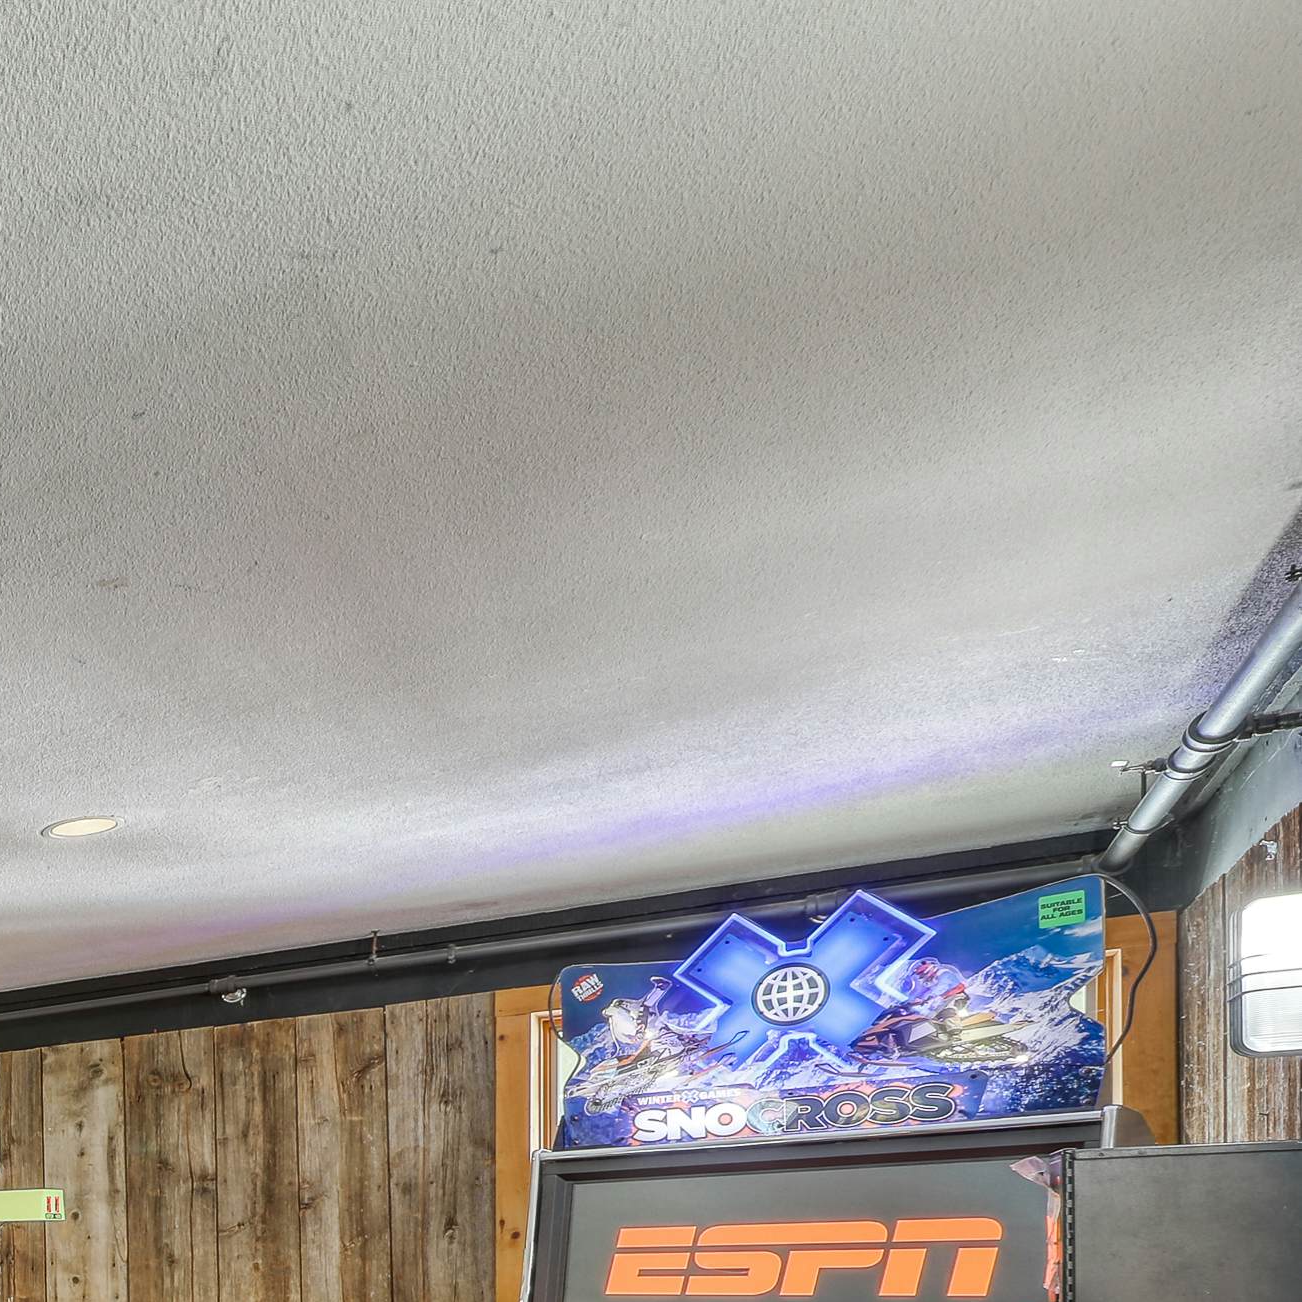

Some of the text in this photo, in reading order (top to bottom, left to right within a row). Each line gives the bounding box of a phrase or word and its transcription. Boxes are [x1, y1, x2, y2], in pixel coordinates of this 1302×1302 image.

[1040, 898, 1082, 909] SUITABLE
[1059, 909, 1083, 917] AGES
[637, 1088, 741, 1105] WINTER GAMES
[632, 1083, 956, 1143] SNOCROSS
[605, 1217, 1003, 1297] ESPN
